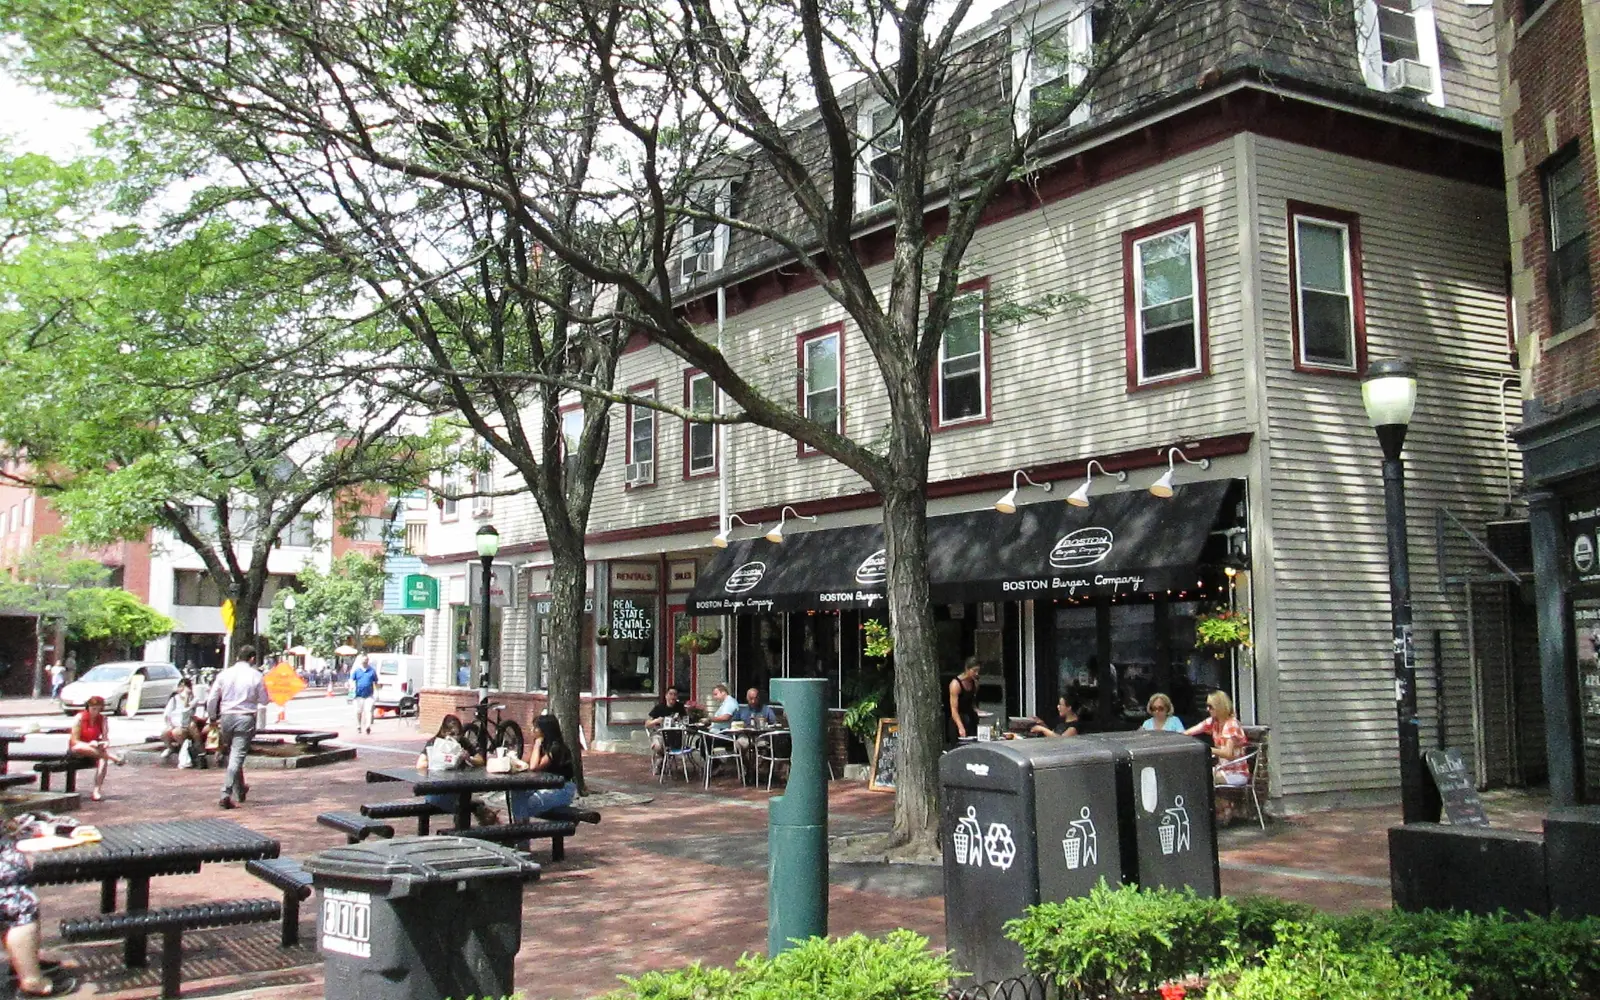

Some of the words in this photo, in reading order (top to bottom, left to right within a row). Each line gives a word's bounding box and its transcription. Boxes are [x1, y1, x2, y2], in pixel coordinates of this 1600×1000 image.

[1062, 536, 1108, 546] BOSTON
[616, 572, 652, 581] RENTALS
[1002, 580, 1048, 591] BOSTON
[1052, 577, 1090, 595] Burger
[1094, 574, 1145, 592] Company
[819, 593, 854, 602] BOSTON
[855, 590, 884, 607] Burger
[613, 599, 636, 609] REAL
[696, 600, 722, 609] BOSTON
[723, 598, 745, 613] Burger
[746, 597, 774, 612] Company
[613, 609, 644, 619] ESTATE
[612, 619, 652, 629] RENTALS
[612, 629, 620, 639] &
[621, 629, 651, 639] SALES
